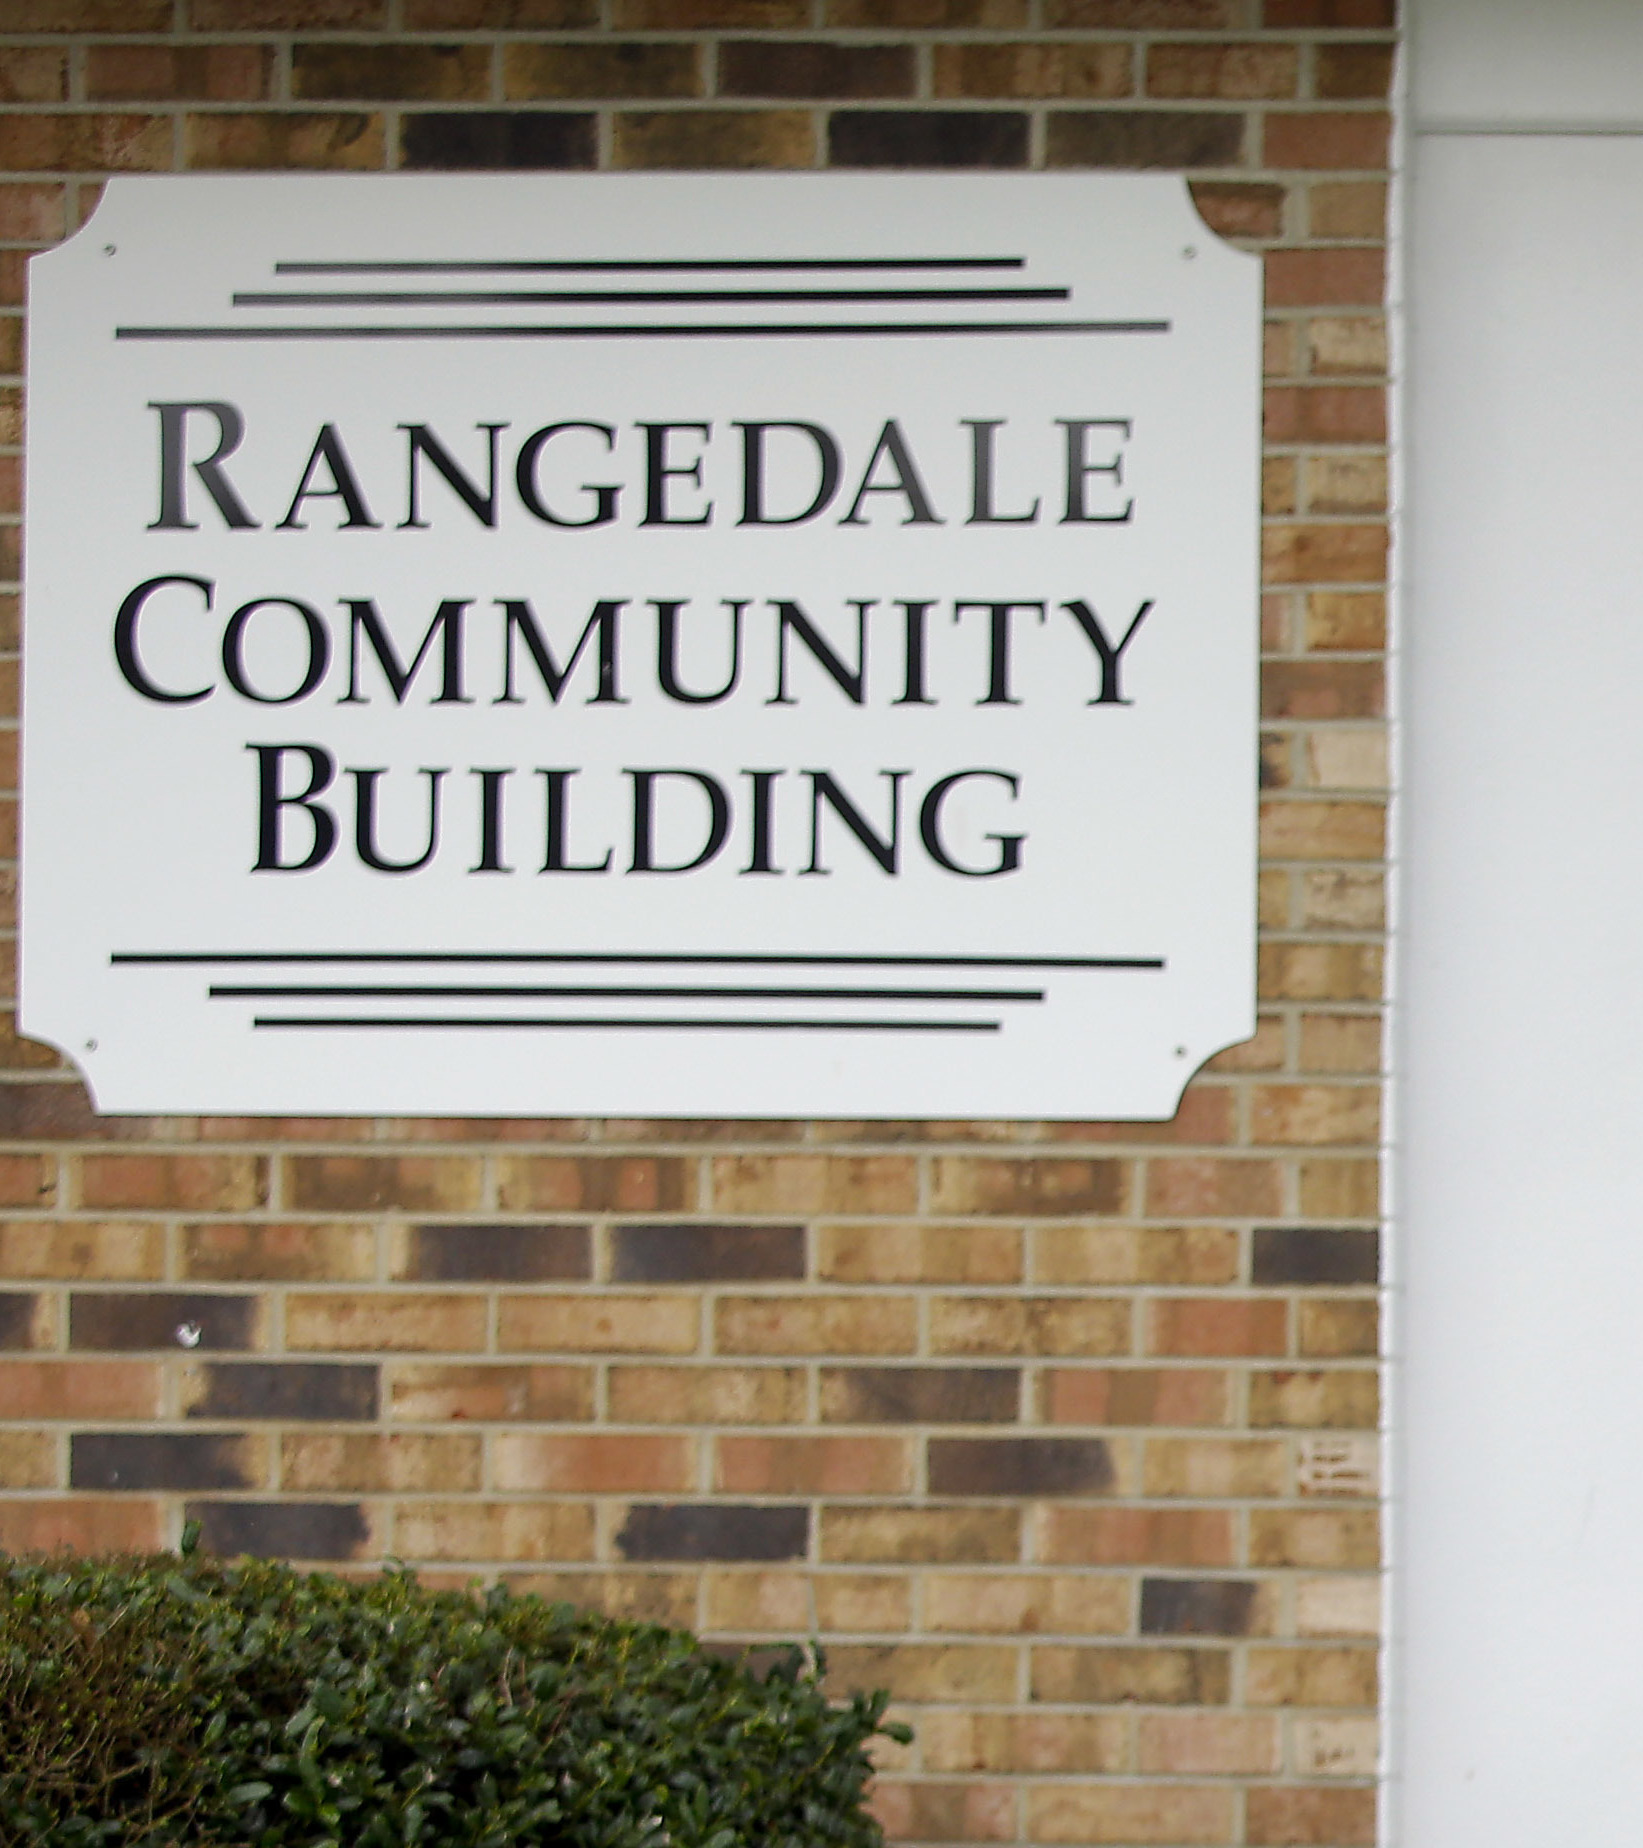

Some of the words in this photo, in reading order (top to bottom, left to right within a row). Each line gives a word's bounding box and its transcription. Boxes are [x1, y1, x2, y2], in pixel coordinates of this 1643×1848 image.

[145, 399, 1134, 531] RANGEDALE
[112, 572, 1154, 706] COMMUNITY
[243, 741, 1026, 878] BUILDING
